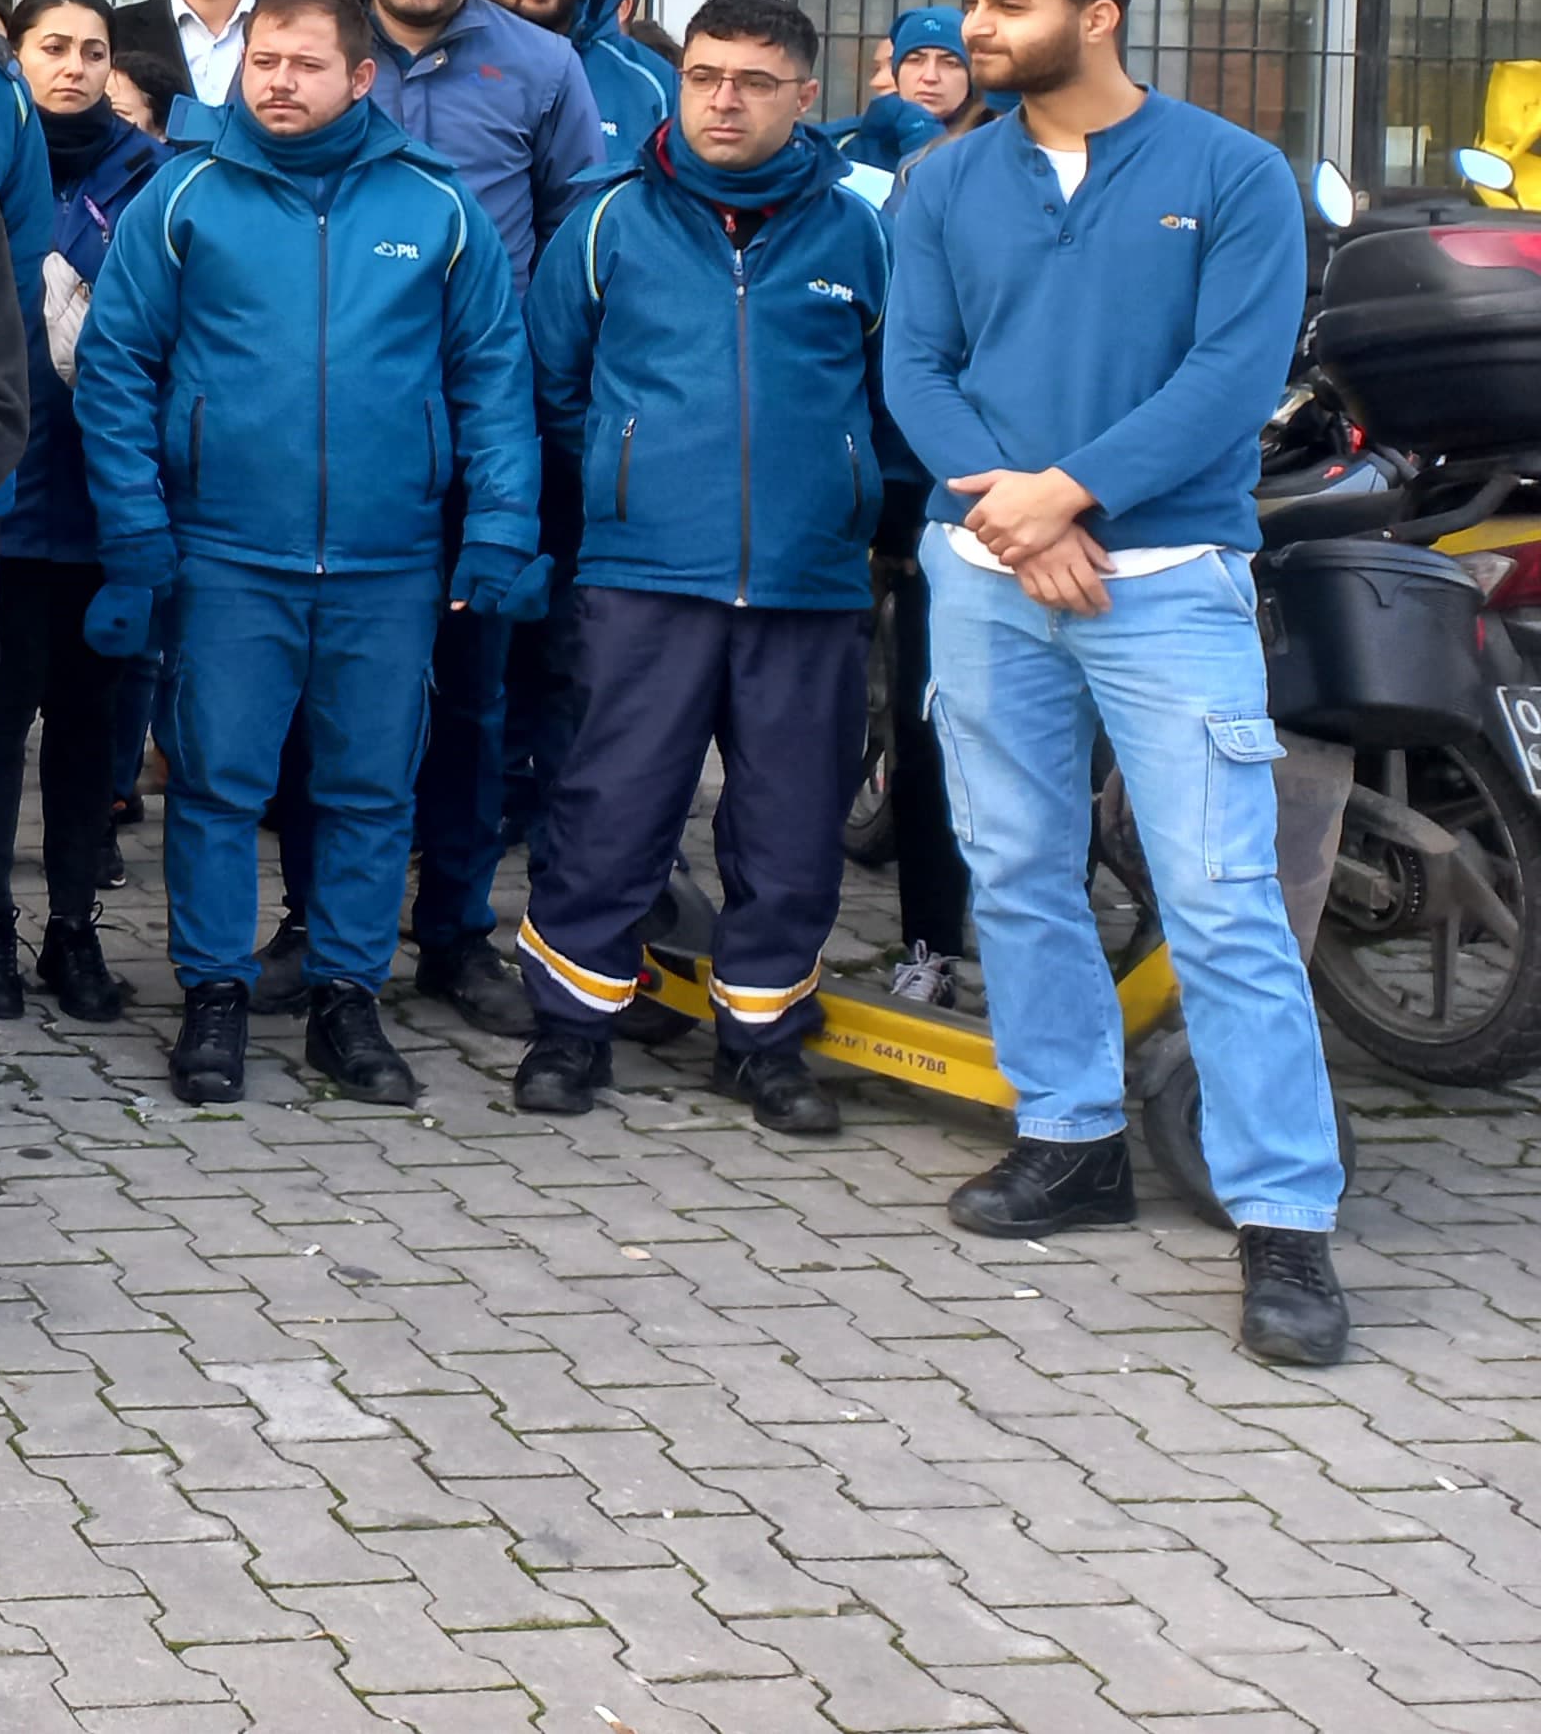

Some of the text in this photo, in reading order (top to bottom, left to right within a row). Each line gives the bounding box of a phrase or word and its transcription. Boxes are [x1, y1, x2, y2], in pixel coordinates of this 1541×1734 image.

[396, 243, 420, 260] Ptt
[831, 283, 854, 303] Ptt
[873, 1043, 903, 1063] 444
